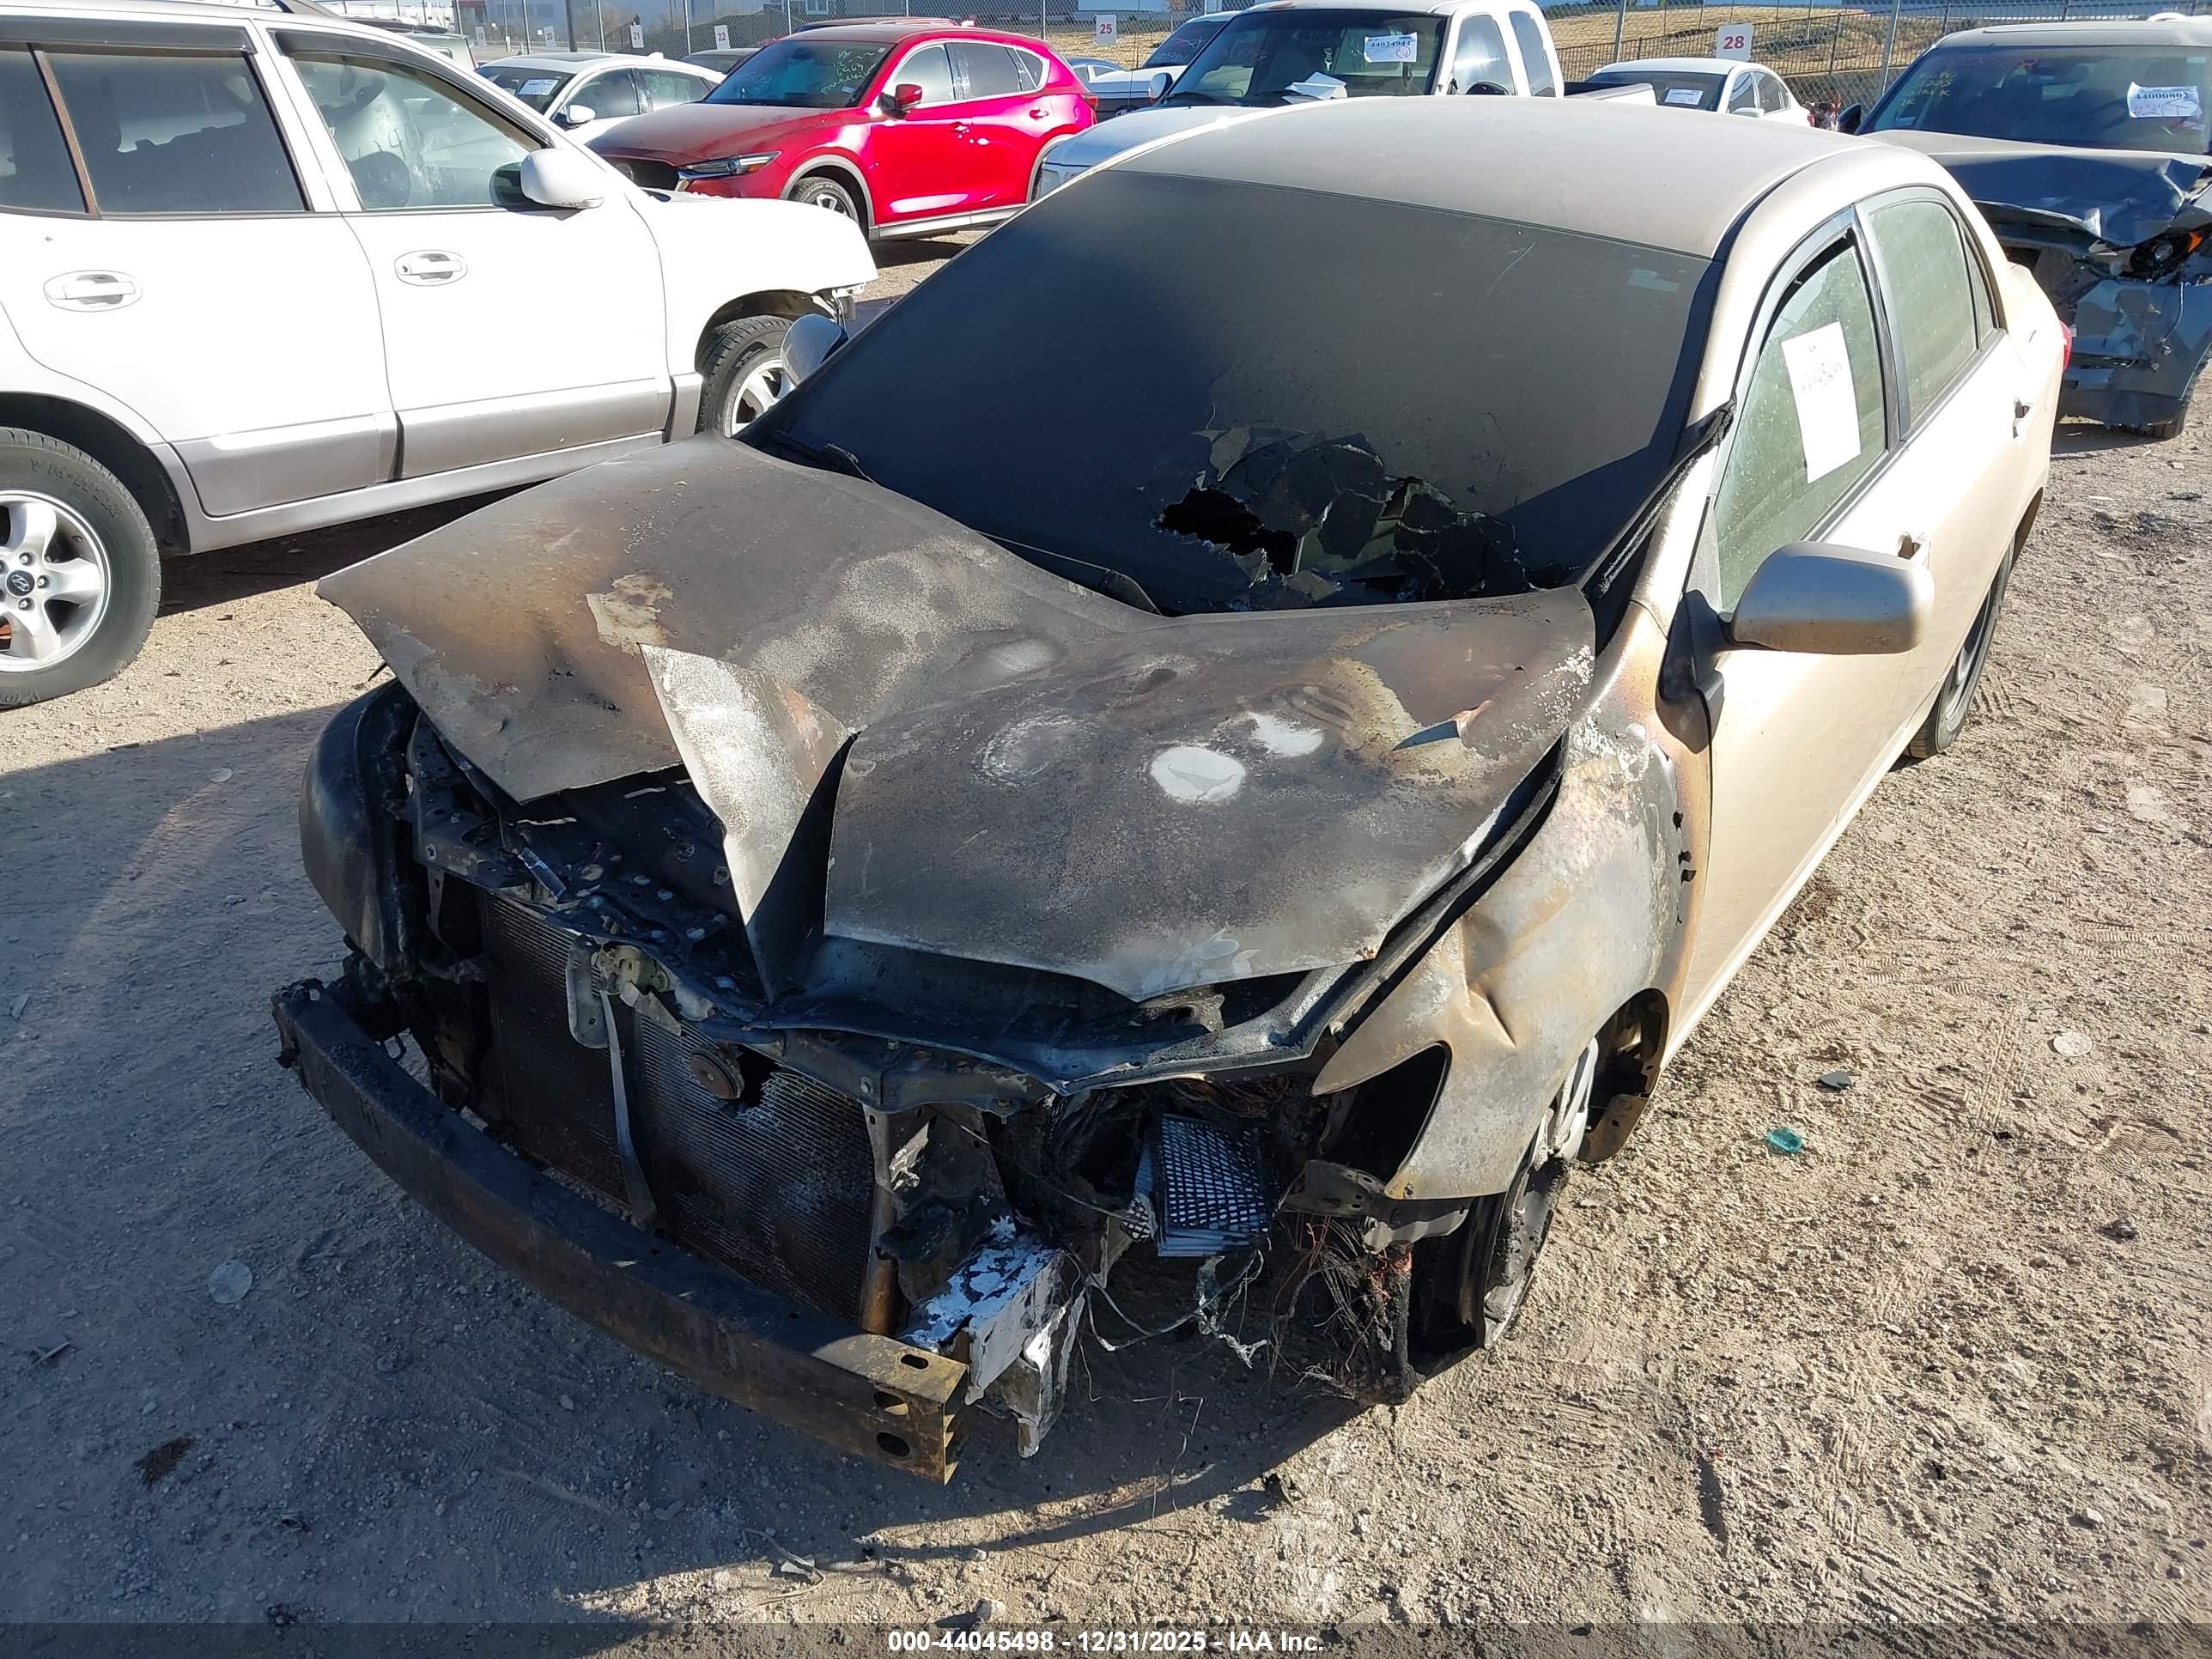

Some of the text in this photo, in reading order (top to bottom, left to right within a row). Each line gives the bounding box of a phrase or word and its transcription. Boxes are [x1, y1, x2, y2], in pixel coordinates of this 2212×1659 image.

[1100, 23, 1113, 34] 25
[633, 31, 641, 40] 21
[717, 32, 726, 41] 22
[1723, 35, 1745, 50] 28
